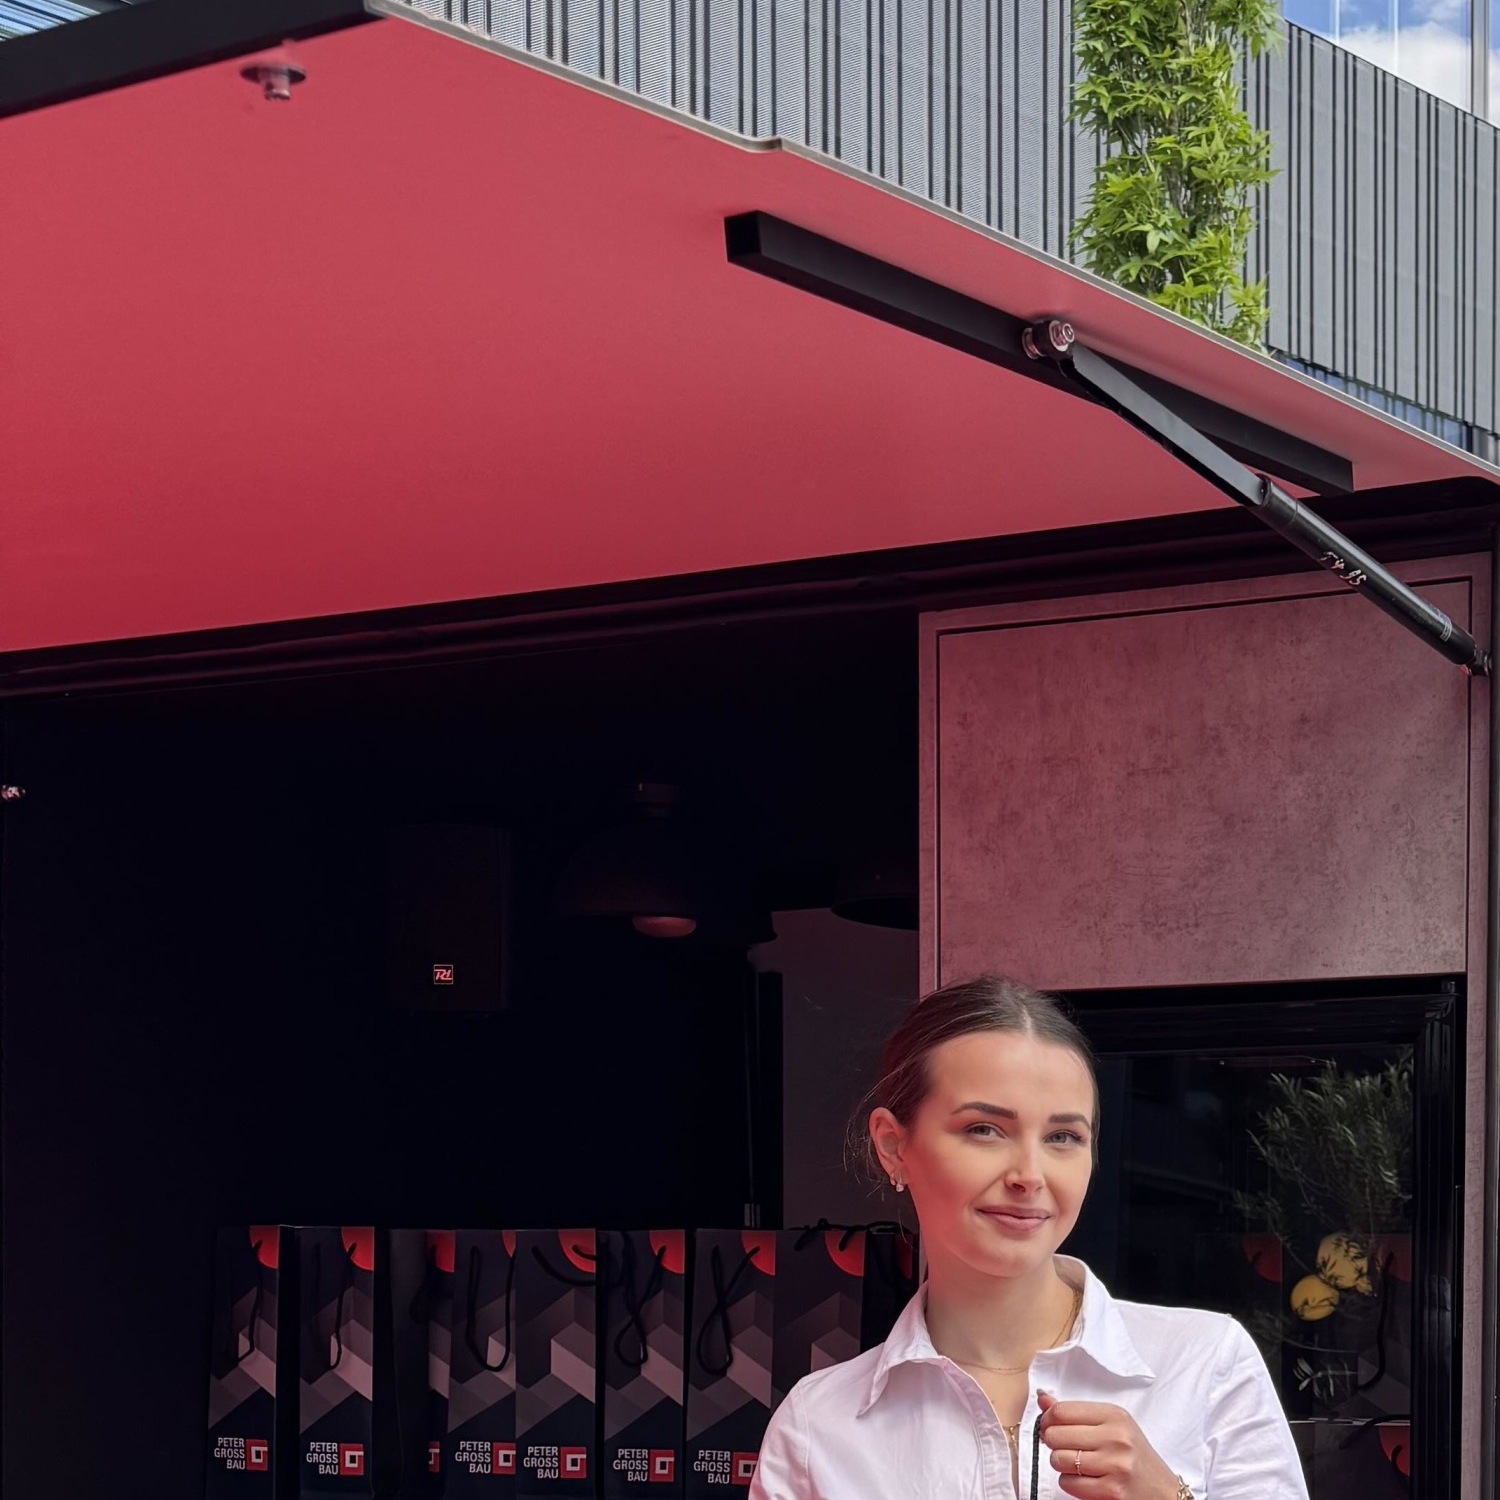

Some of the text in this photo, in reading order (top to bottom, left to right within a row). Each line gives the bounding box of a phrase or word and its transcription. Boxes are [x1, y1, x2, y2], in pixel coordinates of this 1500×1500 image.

[218, 1437, 245, 1448] PETER
[310, 1441, 338, 1453] PETER
[459, 1441, 491, 1452] PETER
[214, 1447, 245, 1459] GROSS
[527, 1446, 559, 1457] PETER
[617, 1448, 649, 1459] PETER
[698, 1450, 731, 1461] PETER
[306, 1452, 339, 1464] GROSS
[455, 1452, 491, 1463] GROSS
[523, 1457, 559, 1468] GROSS
[226, 1459, 246, 1470] BAU
[318, 1464, 339, 1475] BAU
[469, 1463, 491, 1474] BAU
[612, 1459, 649, 1471] GROSS
[693, 1461, 731, 1473] GROSS
[537, 1468, 559, 1479] BAU
[627, 1471, 649, 1482] BAU
[707, 1473, 730, 1484] BAU
